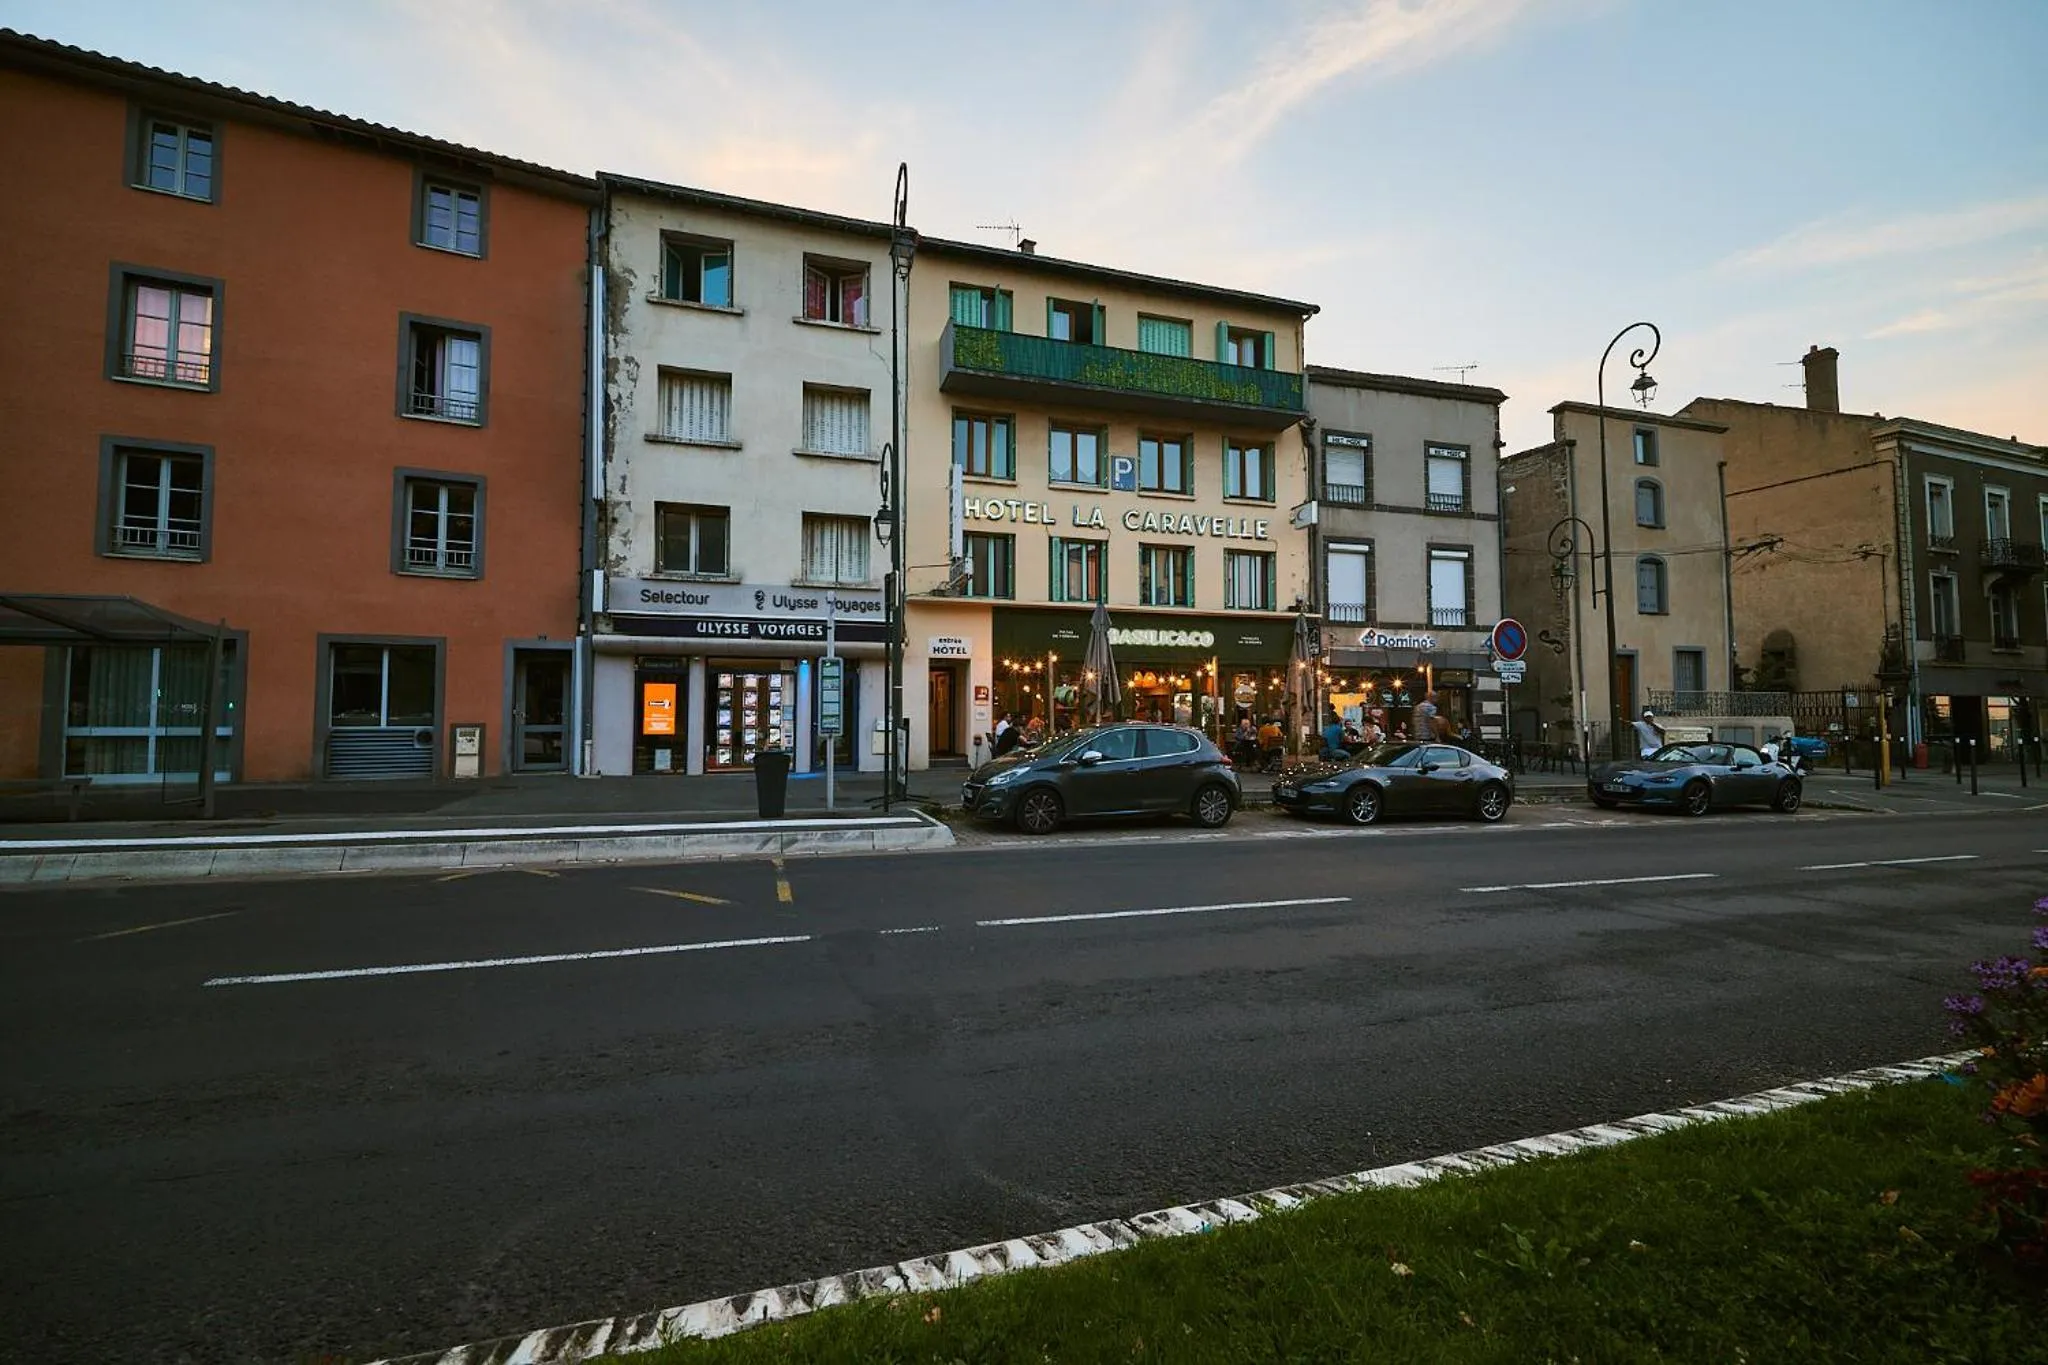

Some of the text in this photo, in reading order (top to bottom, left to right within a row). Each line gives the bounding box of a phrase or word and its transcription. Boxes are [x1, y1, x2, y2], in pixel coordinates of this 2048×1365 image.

[1114, 457, 1133, 482] P
[963, 498, 1269, 540] HOTEL LA CARAVELLE
[640, 589, 710, 606] Selectour
[773, 594, 818, 611] Ulysse
[696, 622, 823, 636] ULYSSE VOYAGES
[1376, 633, 1436, 649] Domino's
